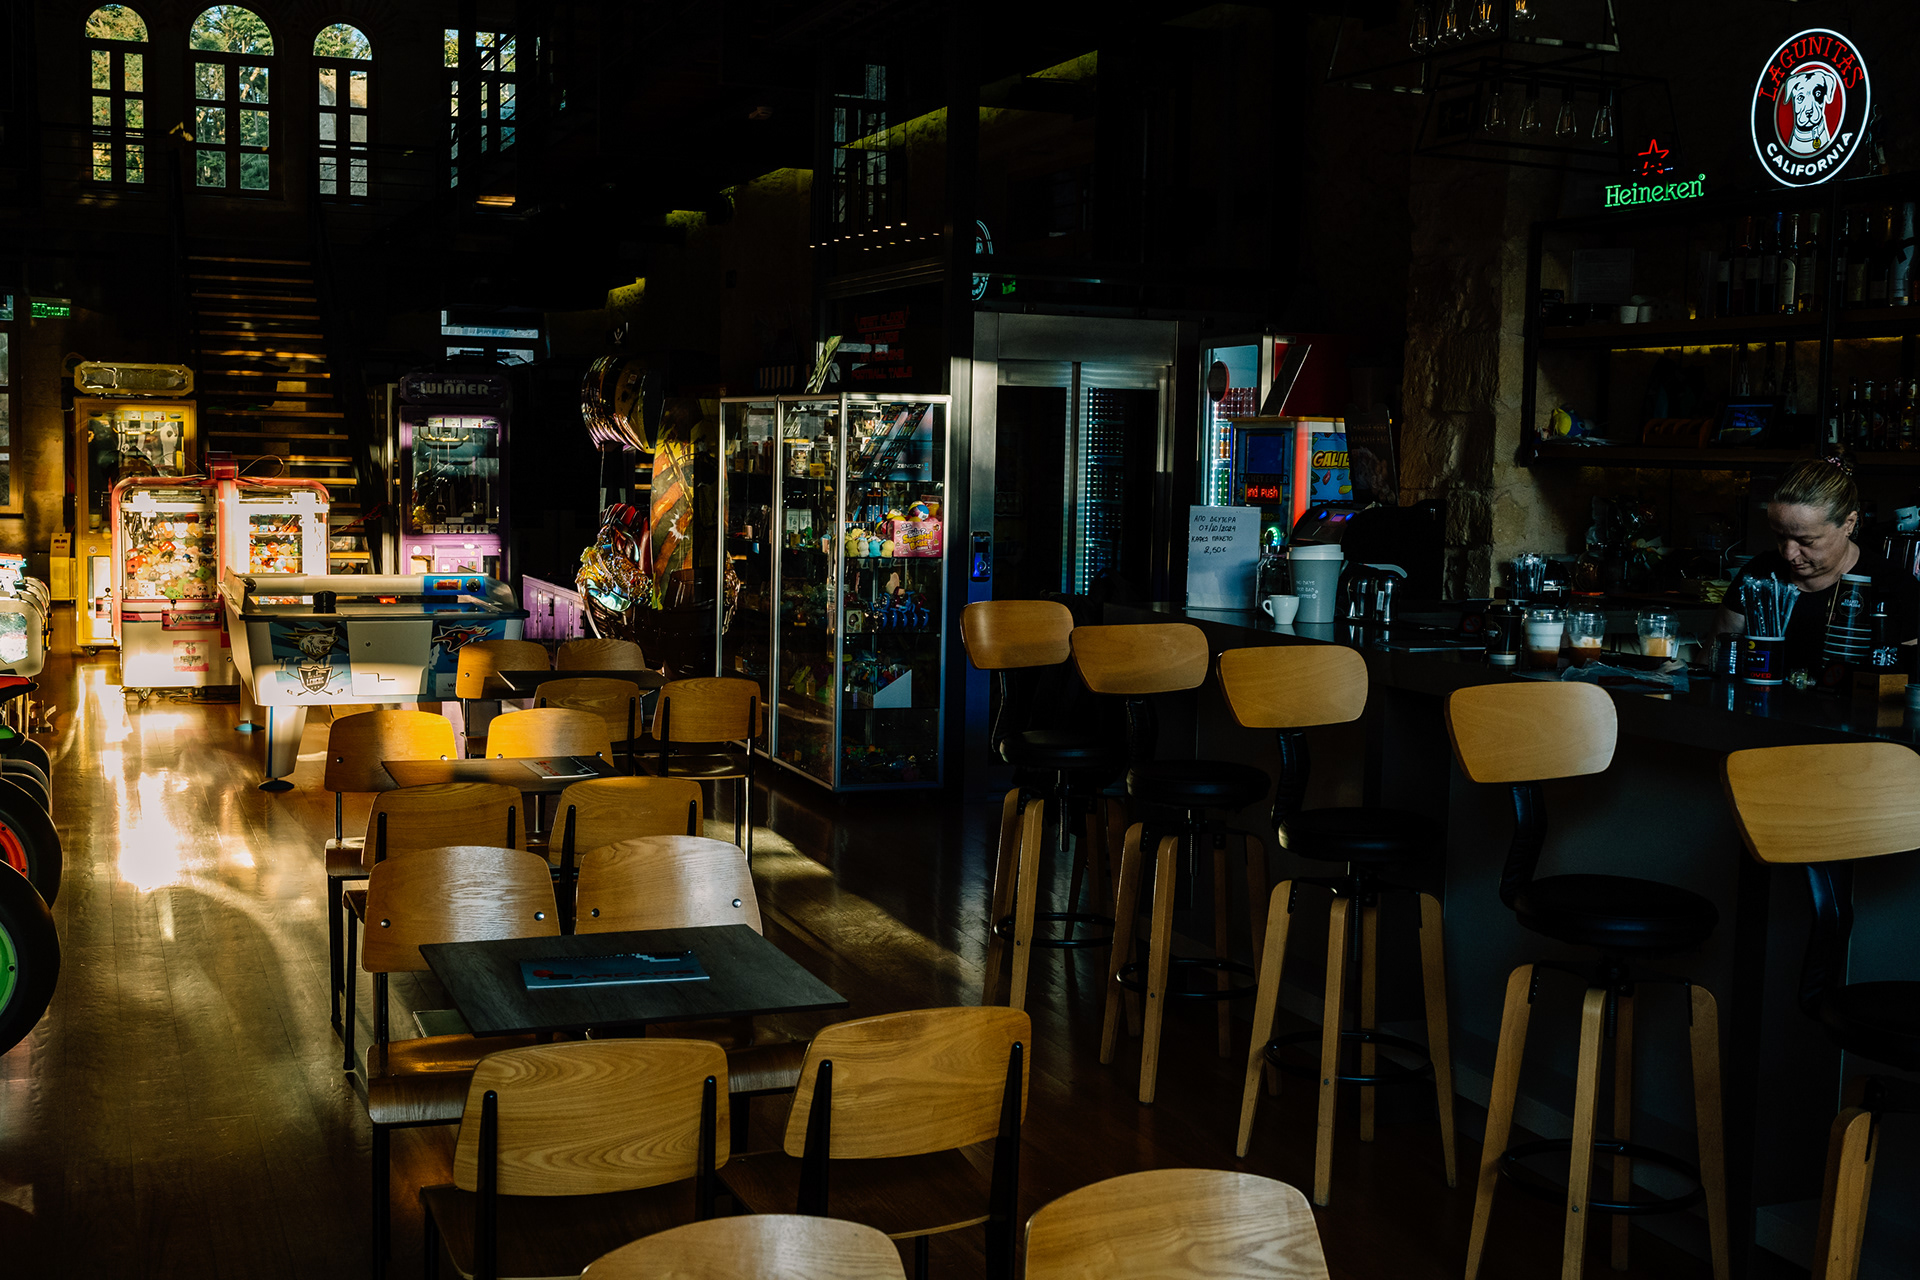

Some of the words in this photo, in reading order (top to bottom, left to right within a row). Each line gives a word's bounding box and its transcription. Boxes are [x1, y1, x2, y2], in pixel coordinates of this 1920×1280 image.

[1758, 36, 1864, 101] LAGUNITAS
[1766, 131, 1853, 177] CALIFORNIA
[1604, 178, 1705, 208] Heineken
[420, 381, 489, 395] WINNER
[1312, 451, 1350, 468] GALIL
[1198, 523, 1236, 532] 07/10/2024
